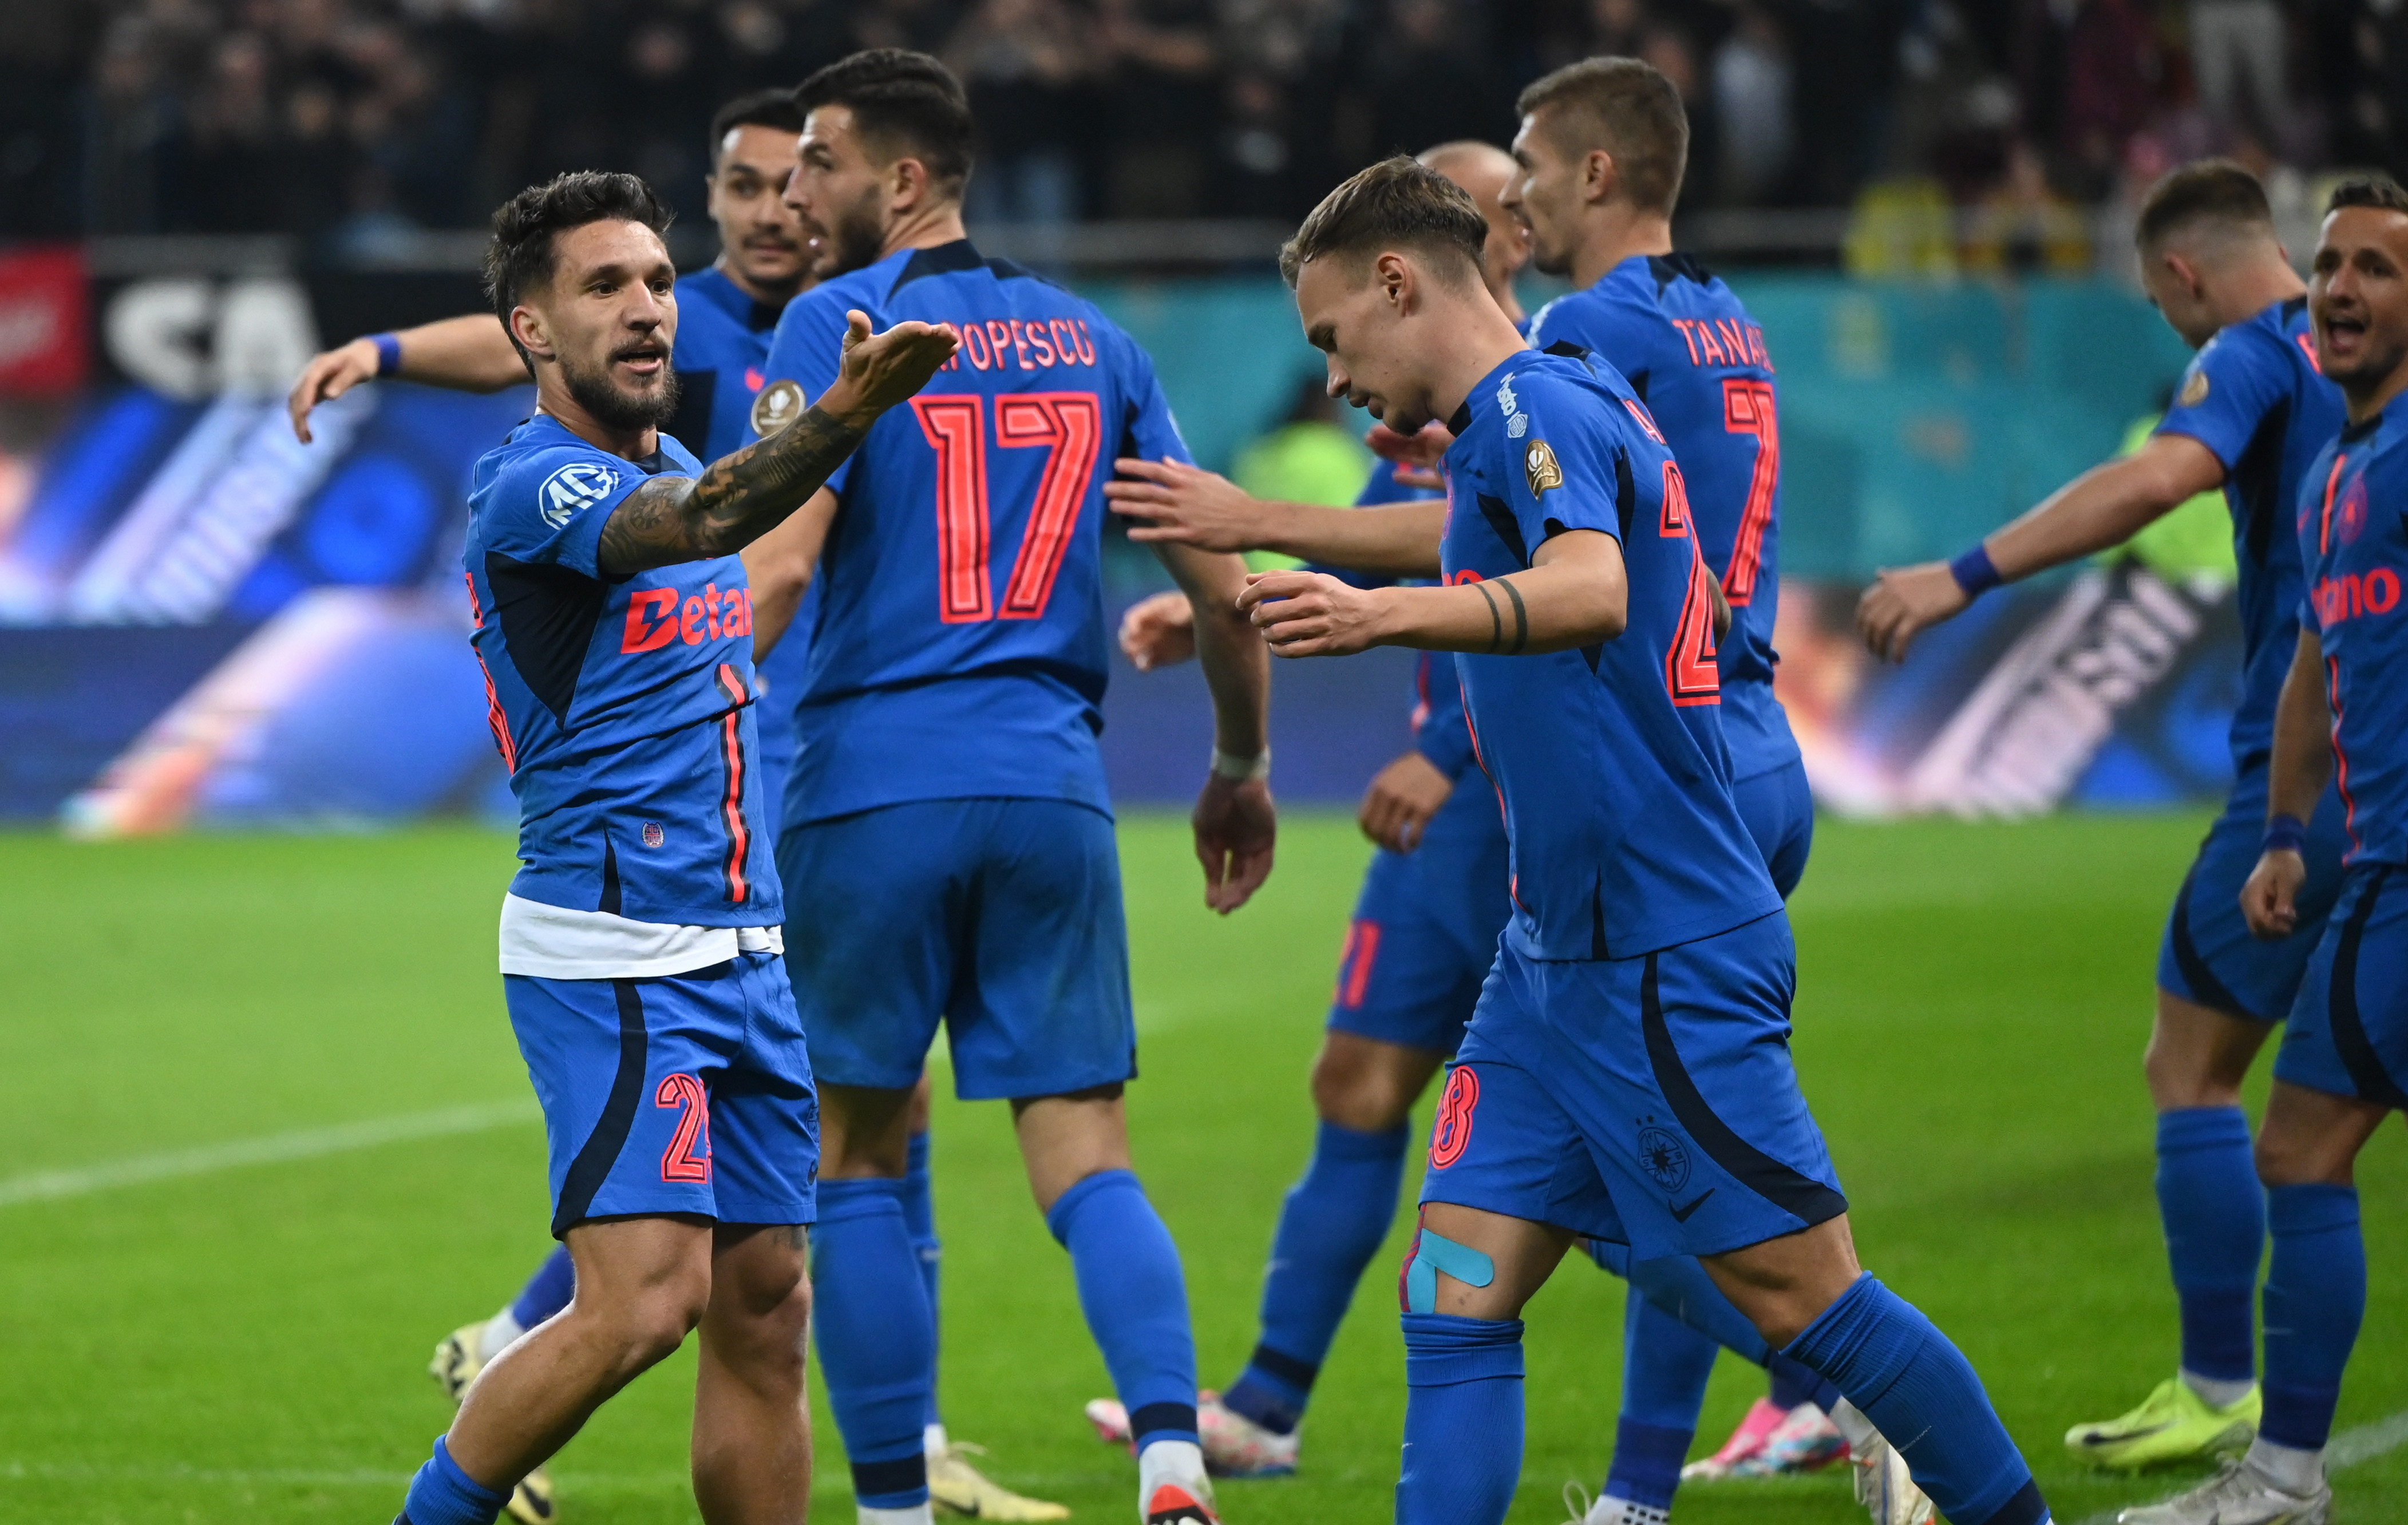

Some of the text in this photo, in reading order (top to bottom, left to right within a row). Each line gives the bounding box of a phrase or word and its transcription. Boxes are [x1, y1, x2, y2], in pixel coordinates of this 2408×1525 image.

[1672, 317, 1776, 374] TANA
[908, 391, 1101, 624] 17
[1722, 378, 1779, 607] 7
[655, 1073, 713, 1185] 2
[1427, 1065, 1480, 1170] 8
